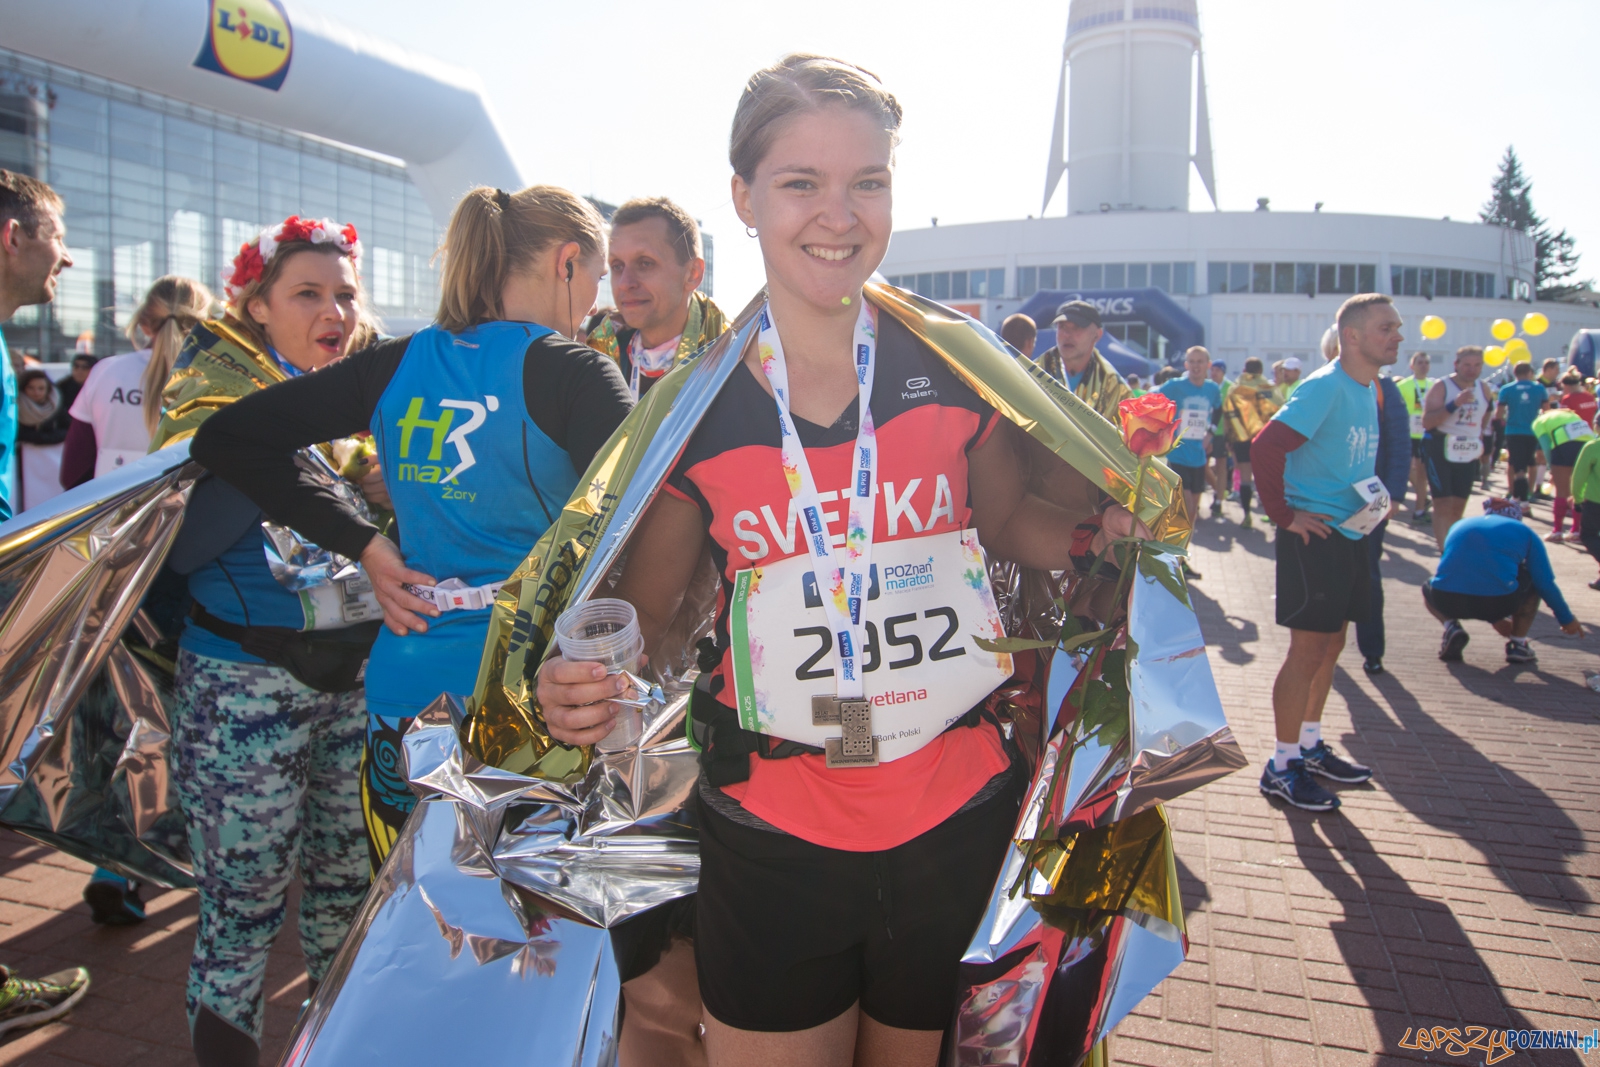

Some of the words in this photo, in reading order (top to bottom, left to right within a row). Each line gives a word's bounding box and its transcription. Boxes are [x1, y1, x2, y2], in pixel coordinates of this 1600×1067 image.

[399, 463, 459, 485] max
[441, 485, 477, 503] Żory
[732, 474, 955, 561] SVEKA
[810, 517, 819, 532] PKO
[886, 573, 934, 591] maraton
[867, 688, 928, 707] vetlana
[856, 725, 867, 733] 25
[899, 727, 921, 738] Polski
